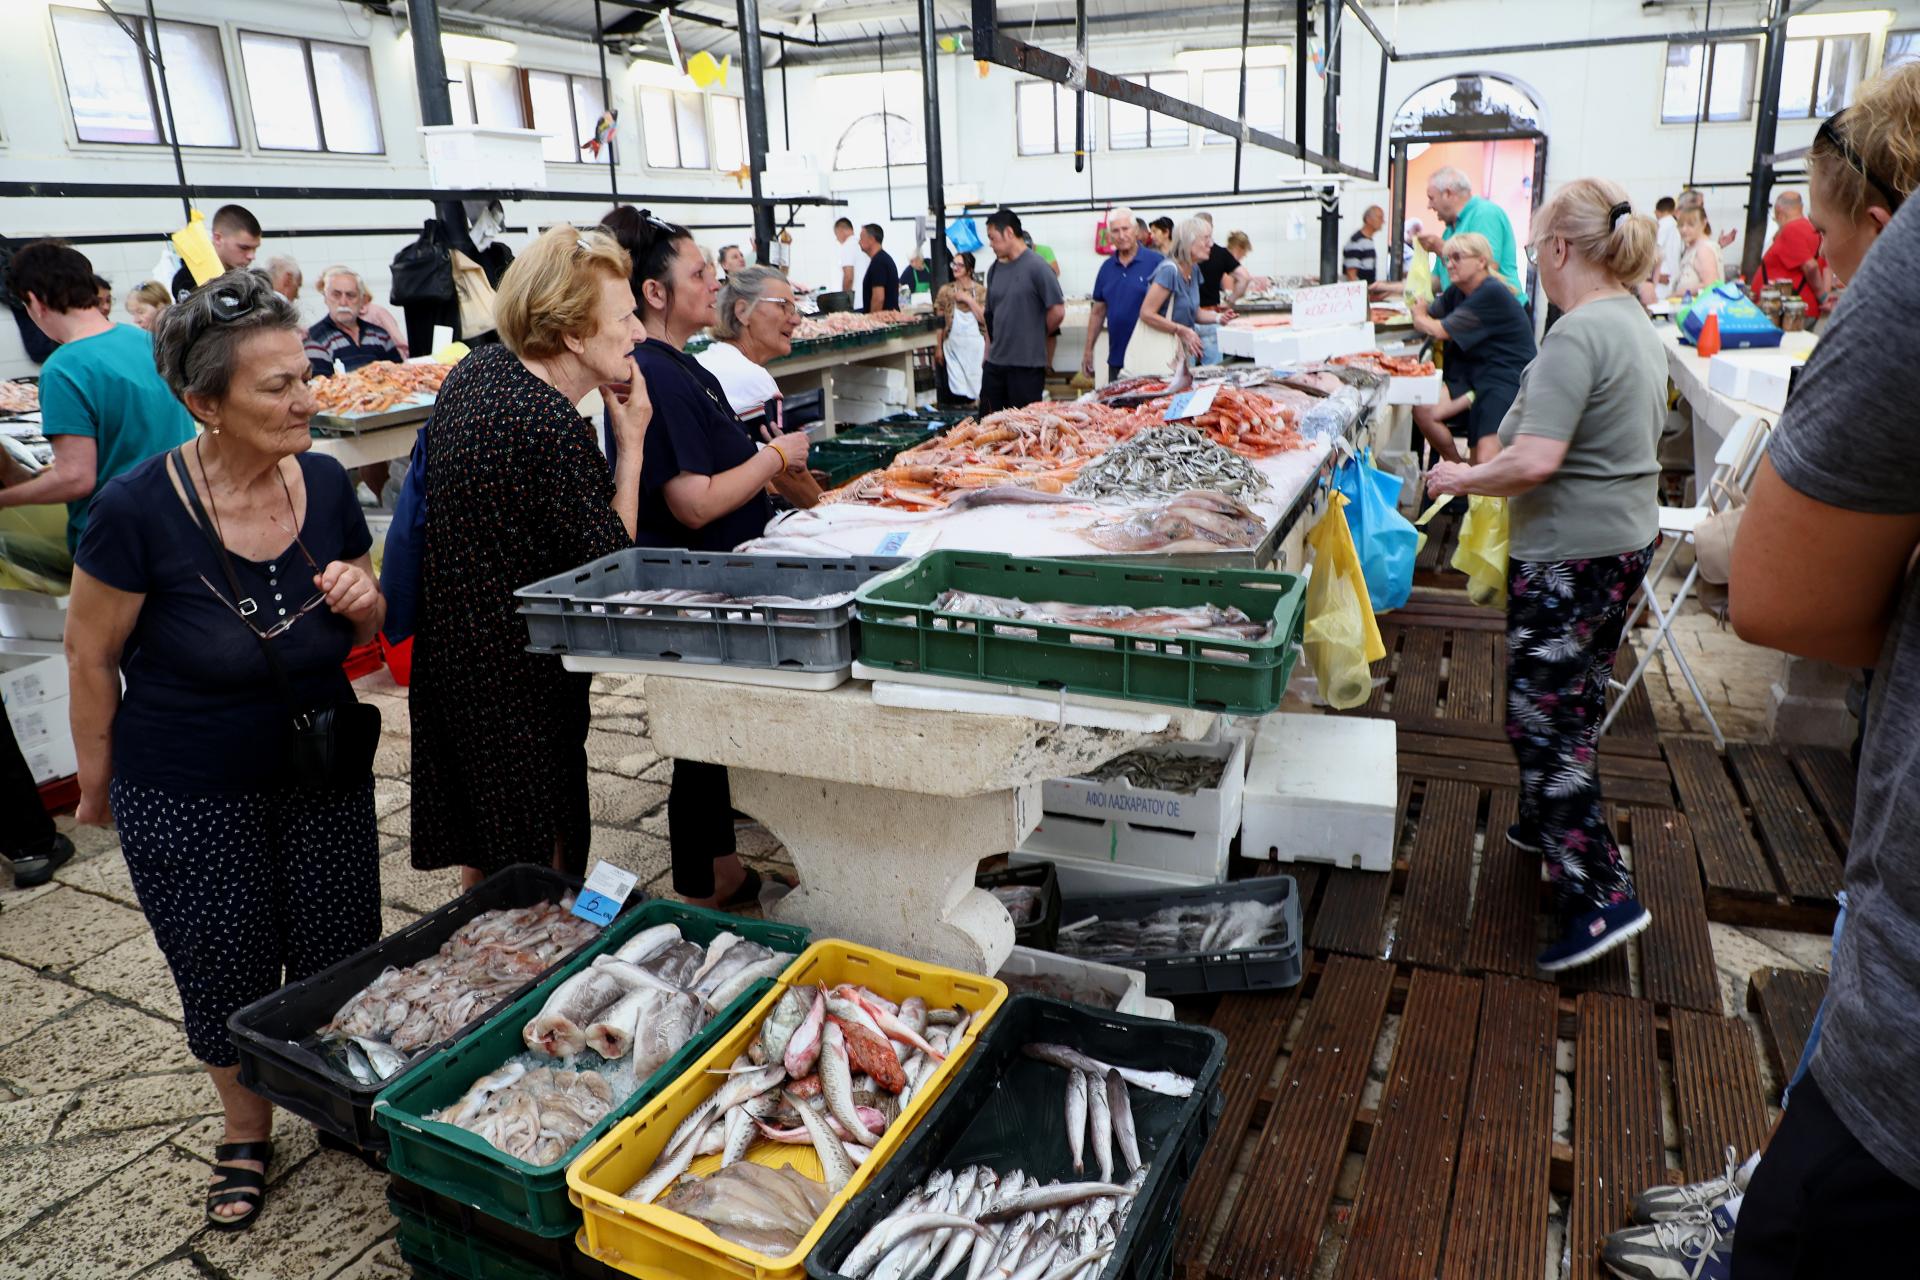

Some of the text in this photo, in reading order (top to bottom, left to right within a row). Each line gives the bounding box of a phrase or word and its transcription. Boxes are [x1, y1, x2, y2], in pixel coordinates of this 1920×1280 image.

[1086, 791, 1180, 817] ΑΦΟΙ ΛΑΣΚΑΡΑΤΟΥ ΟΕ
